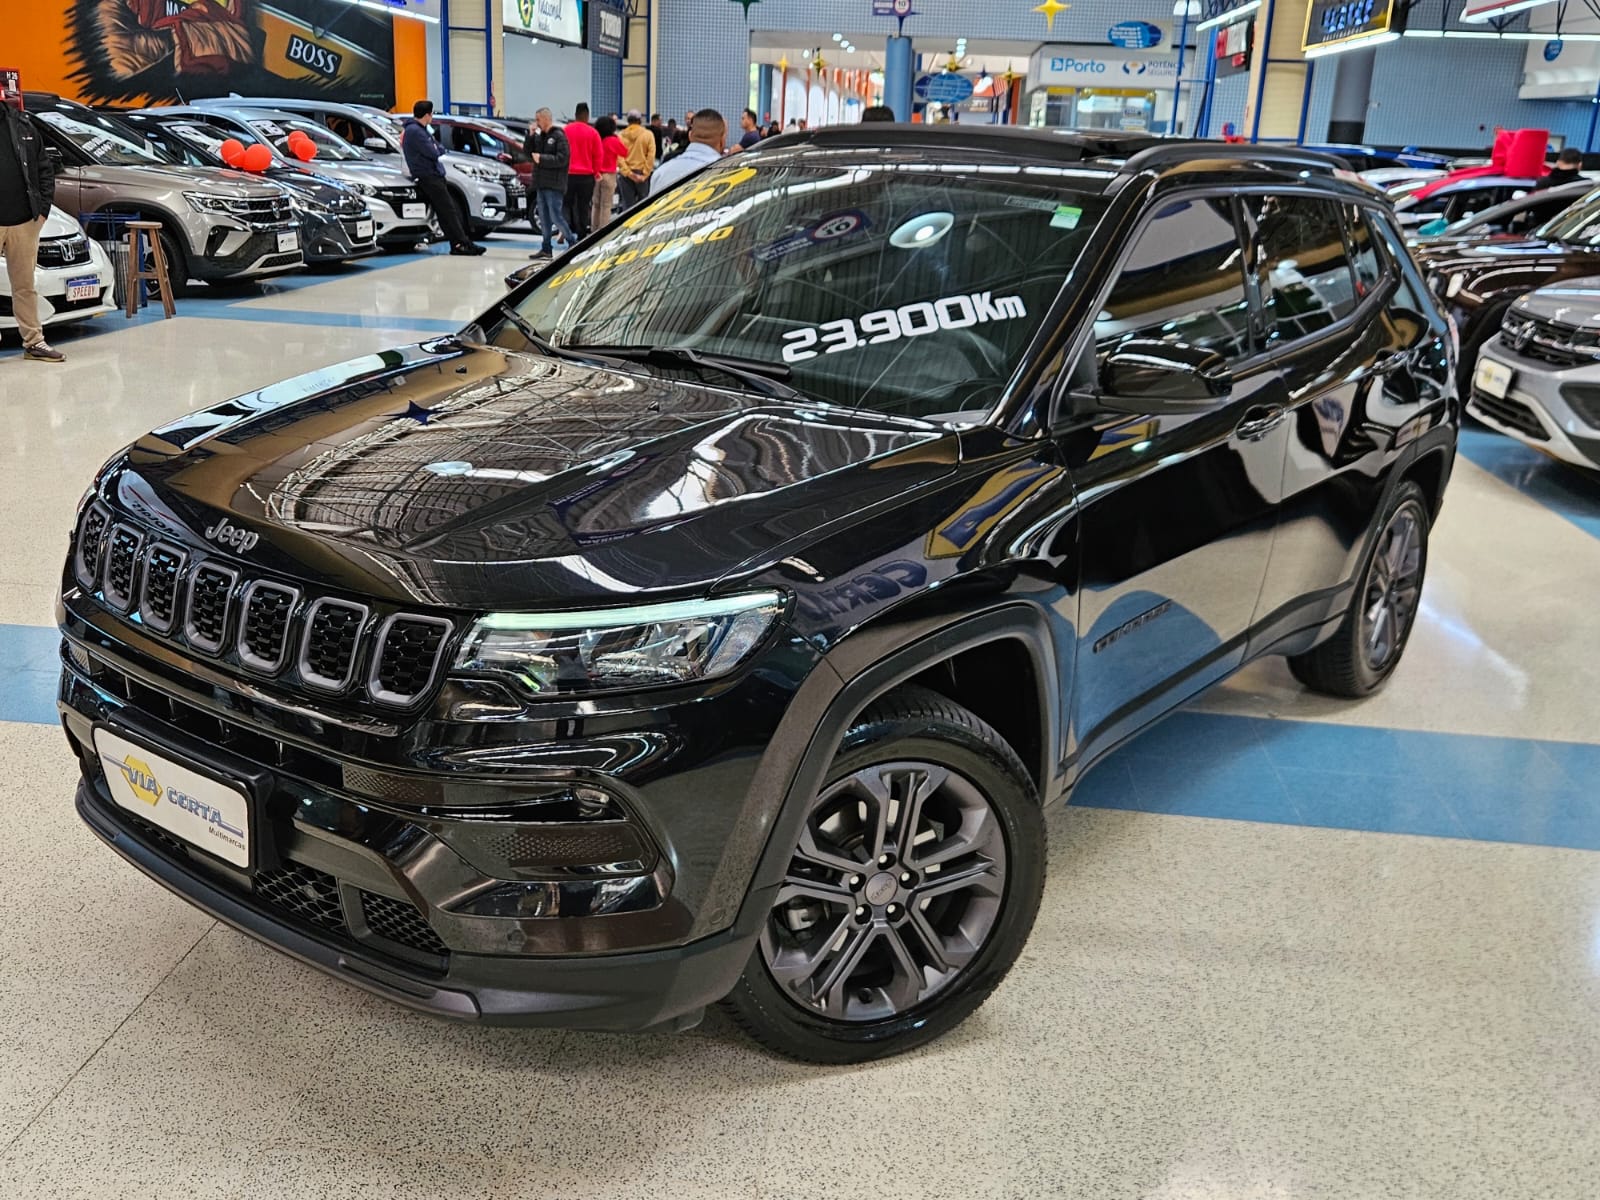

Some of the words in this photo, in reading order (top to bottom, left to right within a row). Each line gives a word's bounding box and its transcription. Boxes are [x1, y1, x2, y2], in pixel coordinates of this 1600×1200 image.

[290, 37, 338, 73] BOSS
[1065, 58, 1106, 73] Porto
[781, 290, 1027, 363] 23.900Km
[205, 517, 260, 554] Jeep
[127, 766, 159, 797] VIA
[208, 825, 246, 851] Multimarcas
